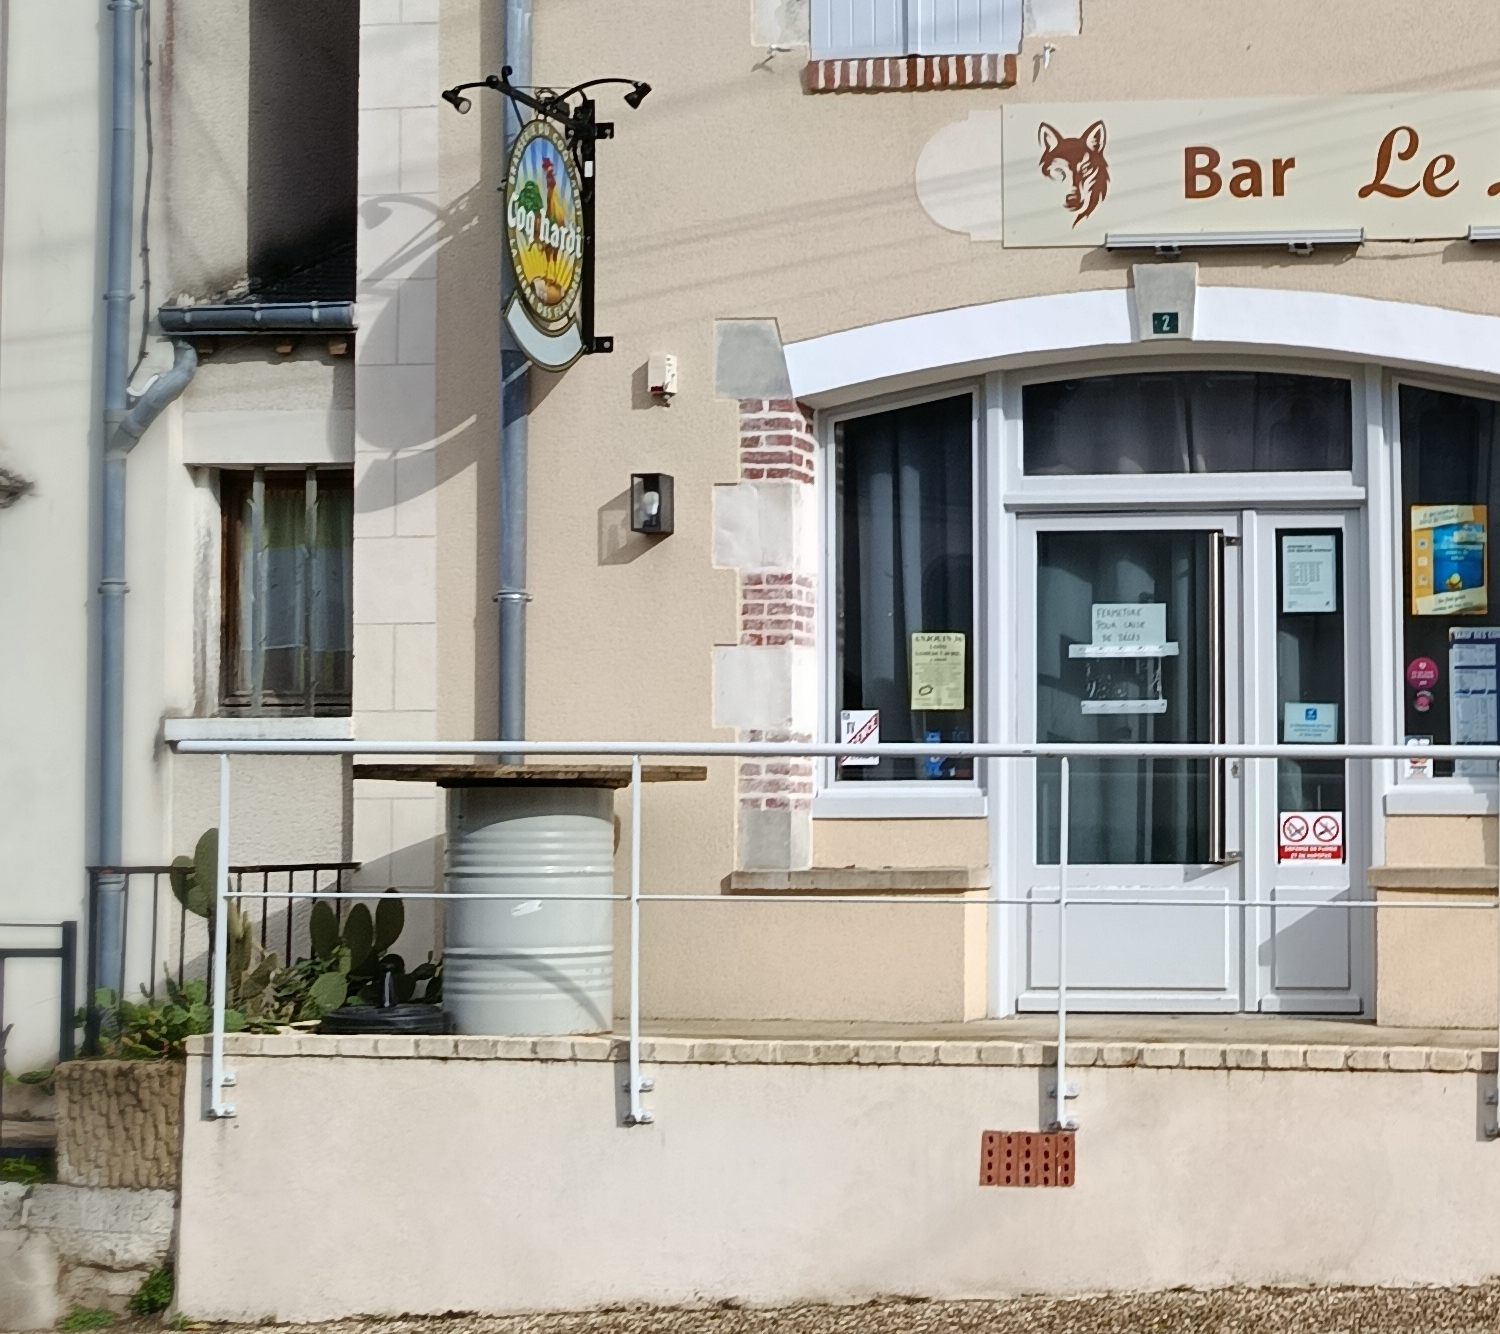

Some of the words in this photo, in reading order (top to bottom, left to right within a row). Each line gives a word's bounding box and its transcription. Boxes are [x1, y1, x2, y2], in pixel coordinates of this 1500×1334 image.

[1184, 146, 1296, 199] Bar
[1358, 125, 1460, 199] Le
[507, 191, 535, 244] Coq
[538, 207, 583, 259] hardi
[1161, 314, 1171, 331] 2
